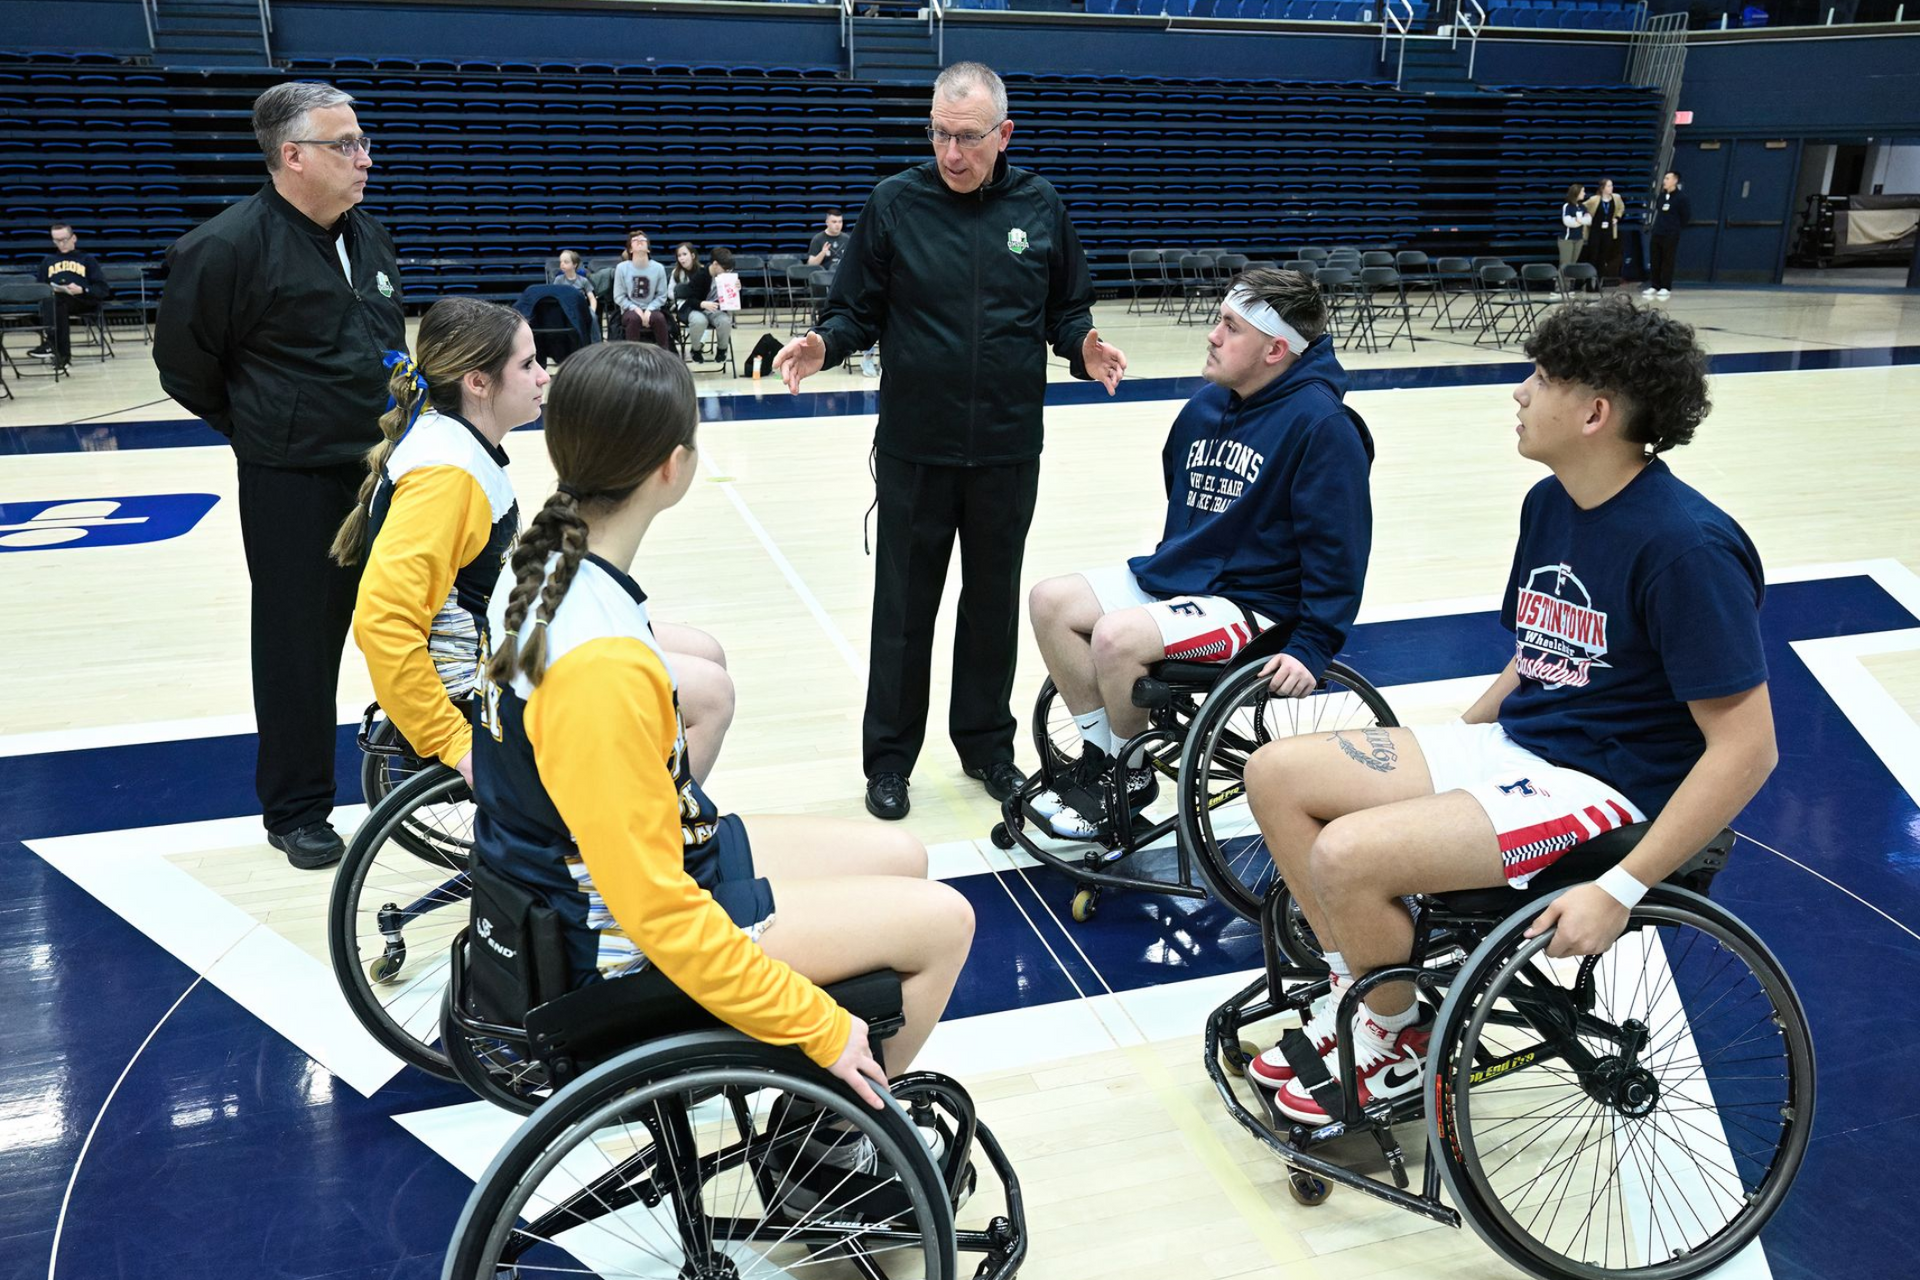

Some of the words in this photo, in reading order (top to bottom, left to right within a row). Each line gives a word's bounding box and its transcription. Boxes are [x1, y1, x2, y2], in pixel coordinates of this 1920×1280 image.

[48, 260, 86, 278] AKRON
[632, 276, 650, 299] B
[1485, 1060, 1511, 1077] End
[1511, 1052, 1535, 1068] Pro
